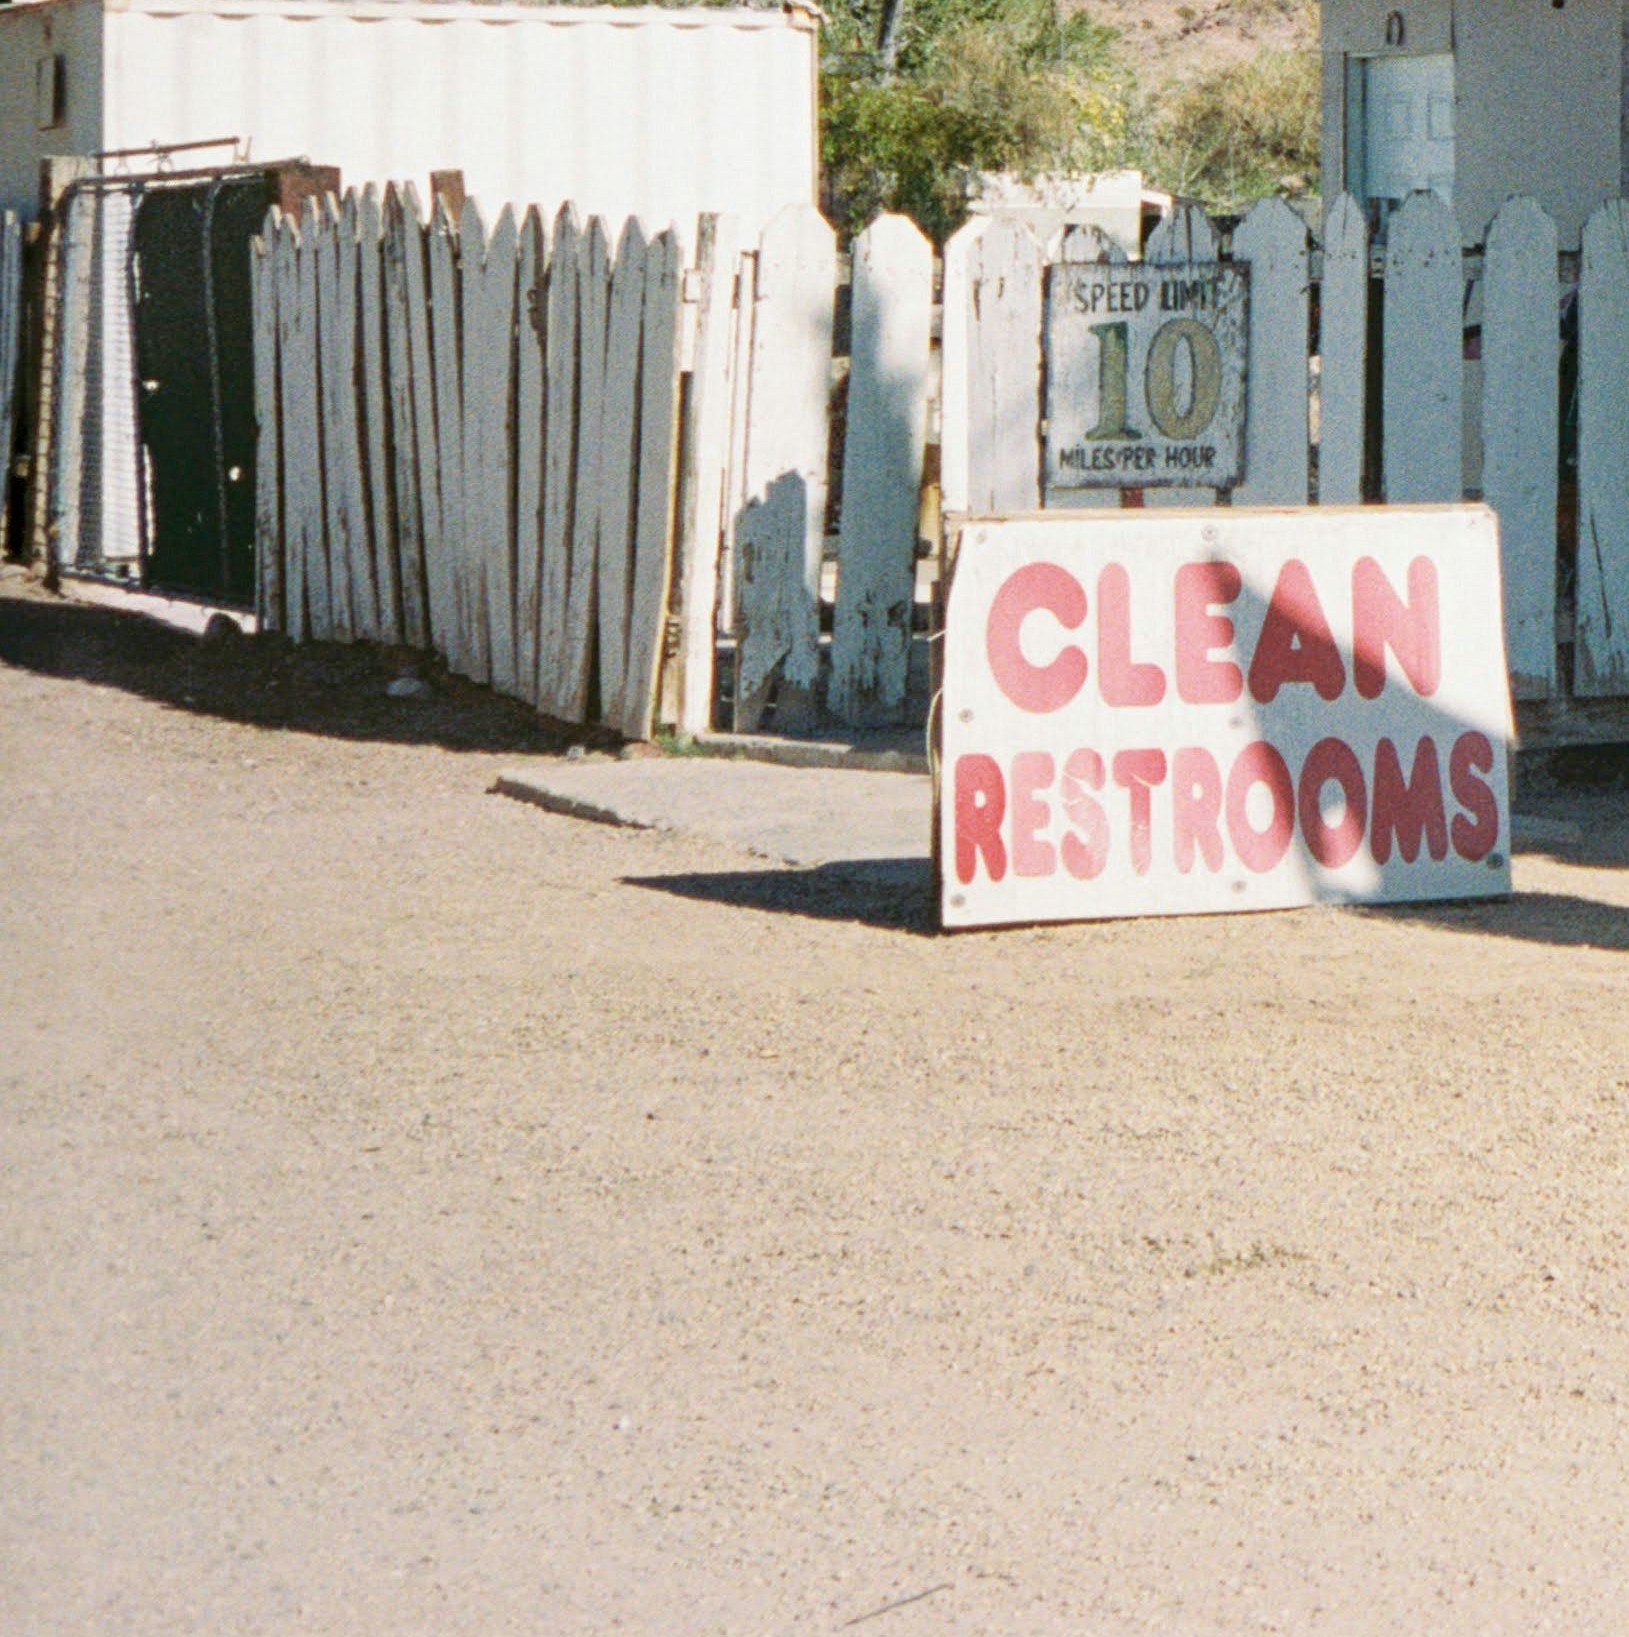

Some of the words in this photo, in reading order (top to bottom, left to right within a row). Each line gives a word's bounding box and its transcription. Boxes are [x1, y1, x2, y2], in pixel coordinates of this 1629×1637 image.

[1073, 278, 1150, 313] SPEED
[1160, 278, 1221, 312] LIMIT
[1084, 317, 1222, 441] 10
[1164, 444, 1217, 469] HOUR
[985, 555, 1440, 714] CLEAN
[953, 729, 1500, 885] RESTROOMS
